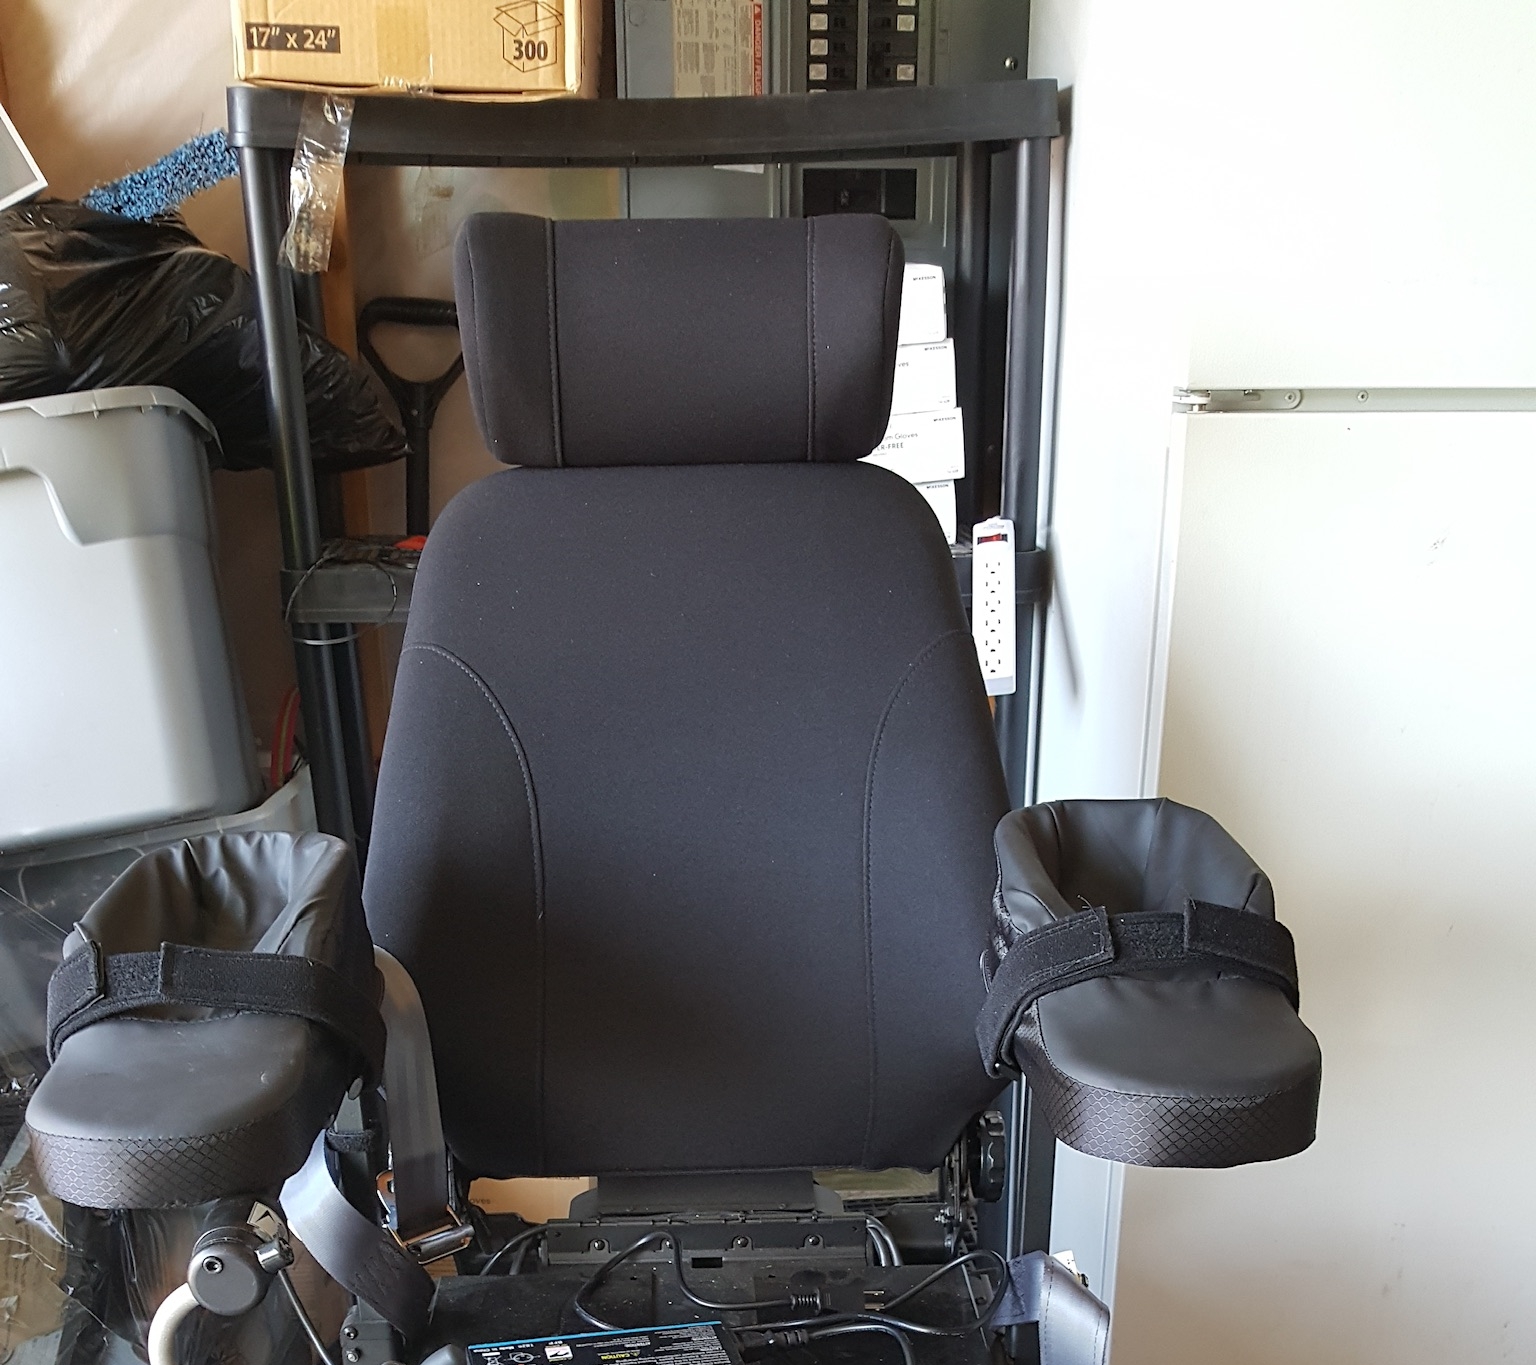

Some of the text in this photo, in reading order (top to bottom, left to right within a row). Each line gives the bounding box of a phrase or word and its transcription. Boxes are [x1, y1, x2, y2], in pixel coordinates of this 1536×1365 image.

[249, 26, 336, 50] 17" x 24"
[513, 39, 548, 61] 300
[754, 19, 762, 58] DANGER
